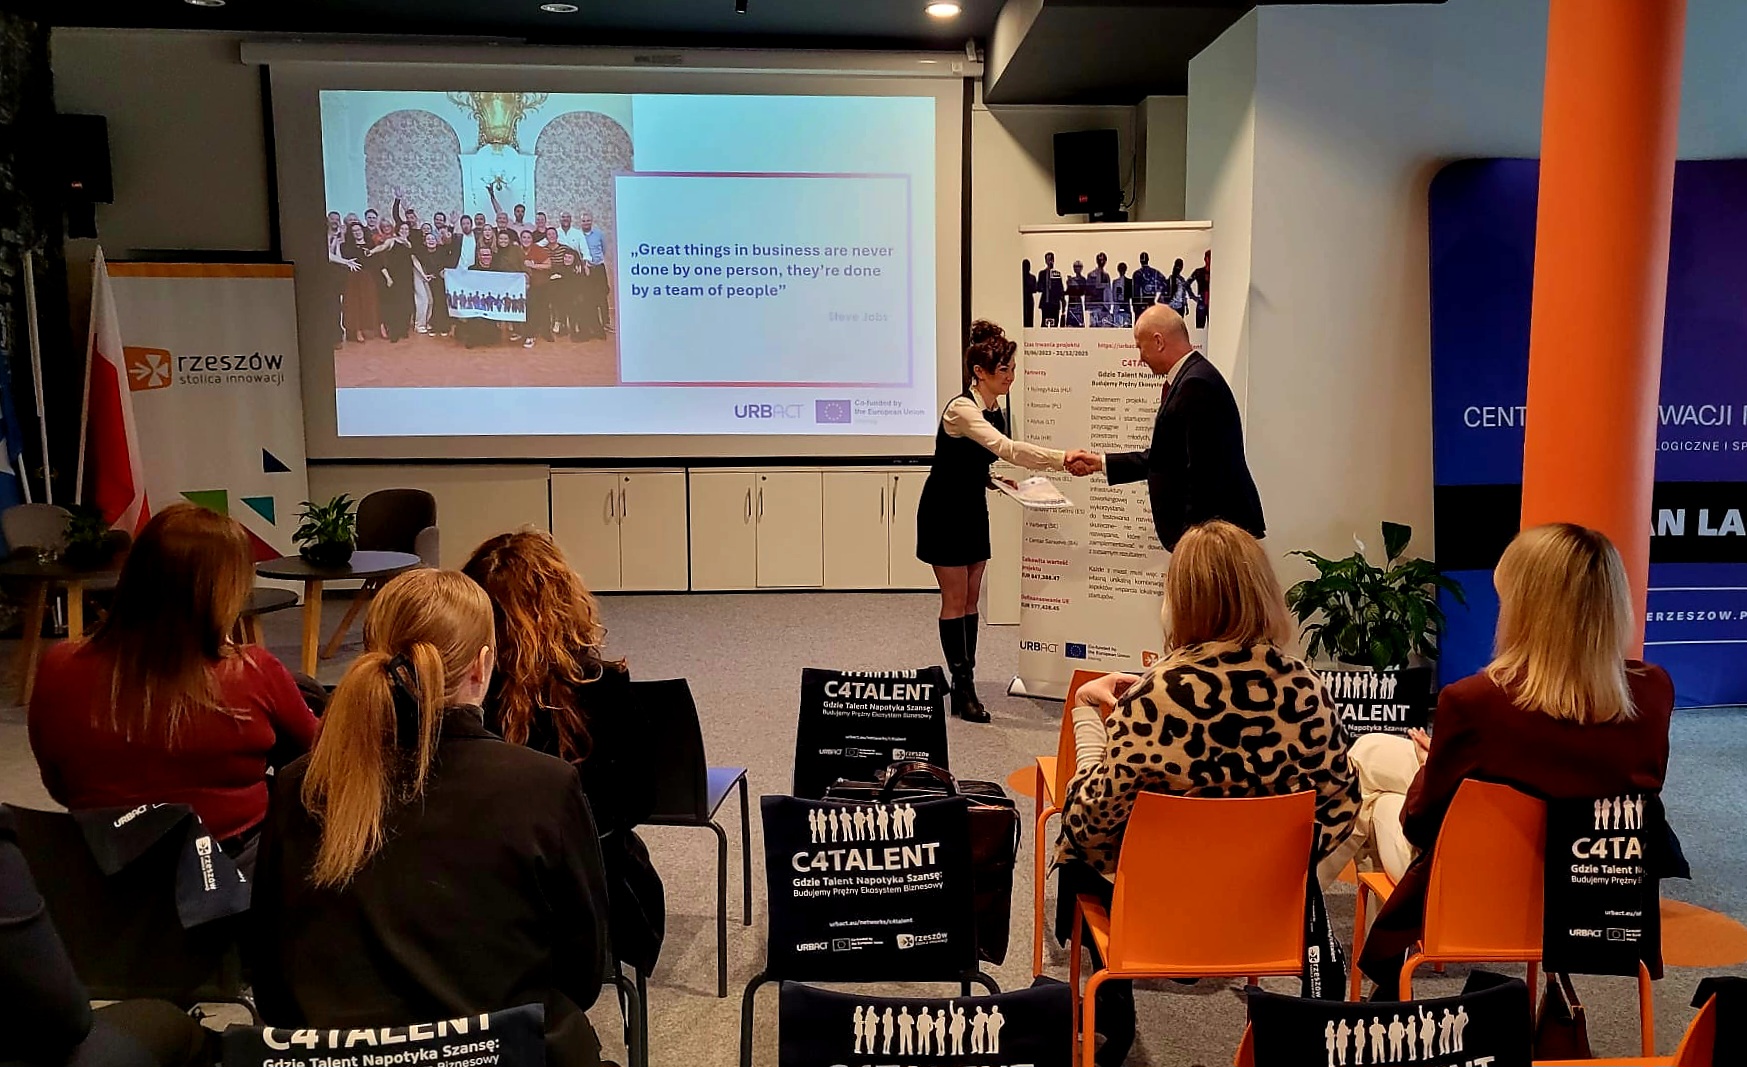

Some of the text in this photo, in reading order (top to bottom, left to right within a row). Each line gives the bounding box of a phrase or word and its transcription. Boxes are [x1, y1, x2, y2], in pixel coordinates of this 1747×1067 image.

[631, 243, 893, 259] „Great things in business are never
[631, 263, 669, 276] done
[673, 263, 690, 279] by
[694, 266, 722, 276] one
[726, 266, 783, 279] person,
[844, 265, 881, 277] done
[631, 284, 786, 299] by a team of people”
[829, 312, 888, 322] Steve Jobs
[178, 352, 283, 372] rzeszów
[1121, 359, 1148, 367] C4TAL
[179, 374, 284, 386] stolica innowacji
[734, 404, 804, 418] URBACT
[854, 399, 903, 408] Co-funded by
[868, 408, 902, 416] European
[1464, 406, 1527, 428] CENT
[1658, 405, 1731, 426] WACJI
[1732, 441, 1747, 451] SP
[1651, 509, 1747, 536] N LA
[1647, 611, 1747, 622] ERZESZOW.P
[1020, 640, 1059, 653] URBACT
[824, 681, 934, 701] C4TALENT
[823, 701, 933, 713] Gdzie Talent Napotyka Szansę:
[1335, 703, 1410, 721] TALENT
[1347, 724, 1382, 732] Napotyka
[113, 804, 148, 828] URBACT
[1571, 837, 1643, 860] C4TA
[791, 842, 940, 873] C4TALENT
[1571, 864, 1599, 874] Gdzie
[1601, 864, 1632, 874] Talent
[793, 871, 943, 887] Gdzie Talent Napotyka Szansę:
[1571, 875, 1637, 885] Budujemy Prężny
[793, 882, 944, 898] Budujemy Prężny Ekosystem Biznesowy
[1569, 929, 1603, 938] URBACT
[797, 942, 829, 952] URBACT
[915, 932, 948, 942] rzeszów
[1313, 963, 1321, 998] rzeszów
[309, 1056, 358, 1067] Talent
[363, 1048, 438, 1067] Napotyka
[443, 1039, 500, 1057] Szansę:
